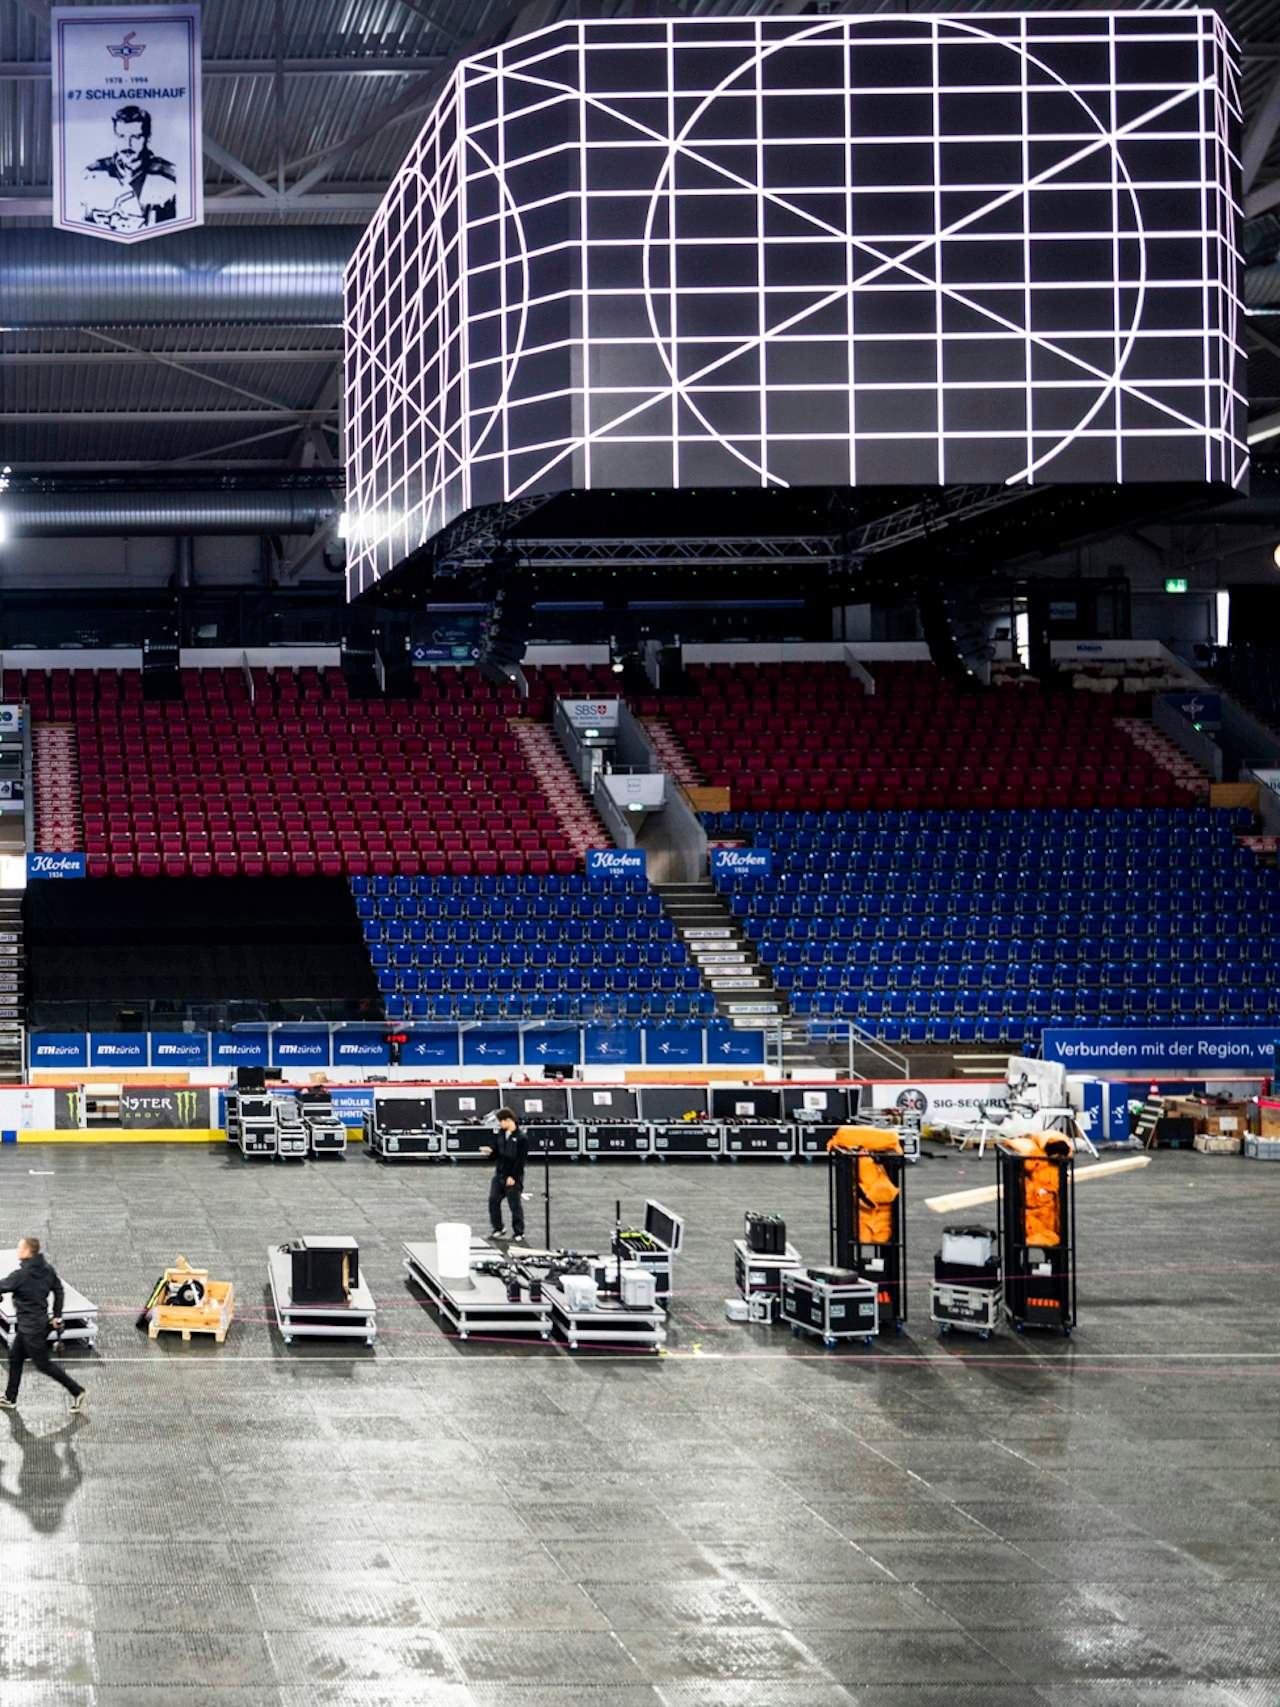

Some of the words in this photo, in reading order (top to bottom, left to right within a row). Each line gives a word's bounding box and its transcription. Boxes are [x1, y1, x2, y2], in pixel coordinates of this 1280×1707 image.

[67, 89, 82, 100] #7
[85, 87, 186, 99] SCHLAGENHAUF
[575, 705, 597, 716] SBS
[31, 857, 80, 872] Kloten
[591, 852, 641, 867] Kloten
[716, 851, 766, 867] Kloten
[1055, 1041, 1138, 1056] Verbunden
[1141, 1042, 1165, 1056] mit
[1168, 1041, 1193, 1056] der
[1198, 1041, 1254, 1059] Region,
[121, 1096, 173, 1111] NSTER
[340, 1097, 370, 1107] MÜLLER
[933, 1099, 1010, 1110] SIG-SECURI
[332, 1110, 364, 1119] WEHNTA
